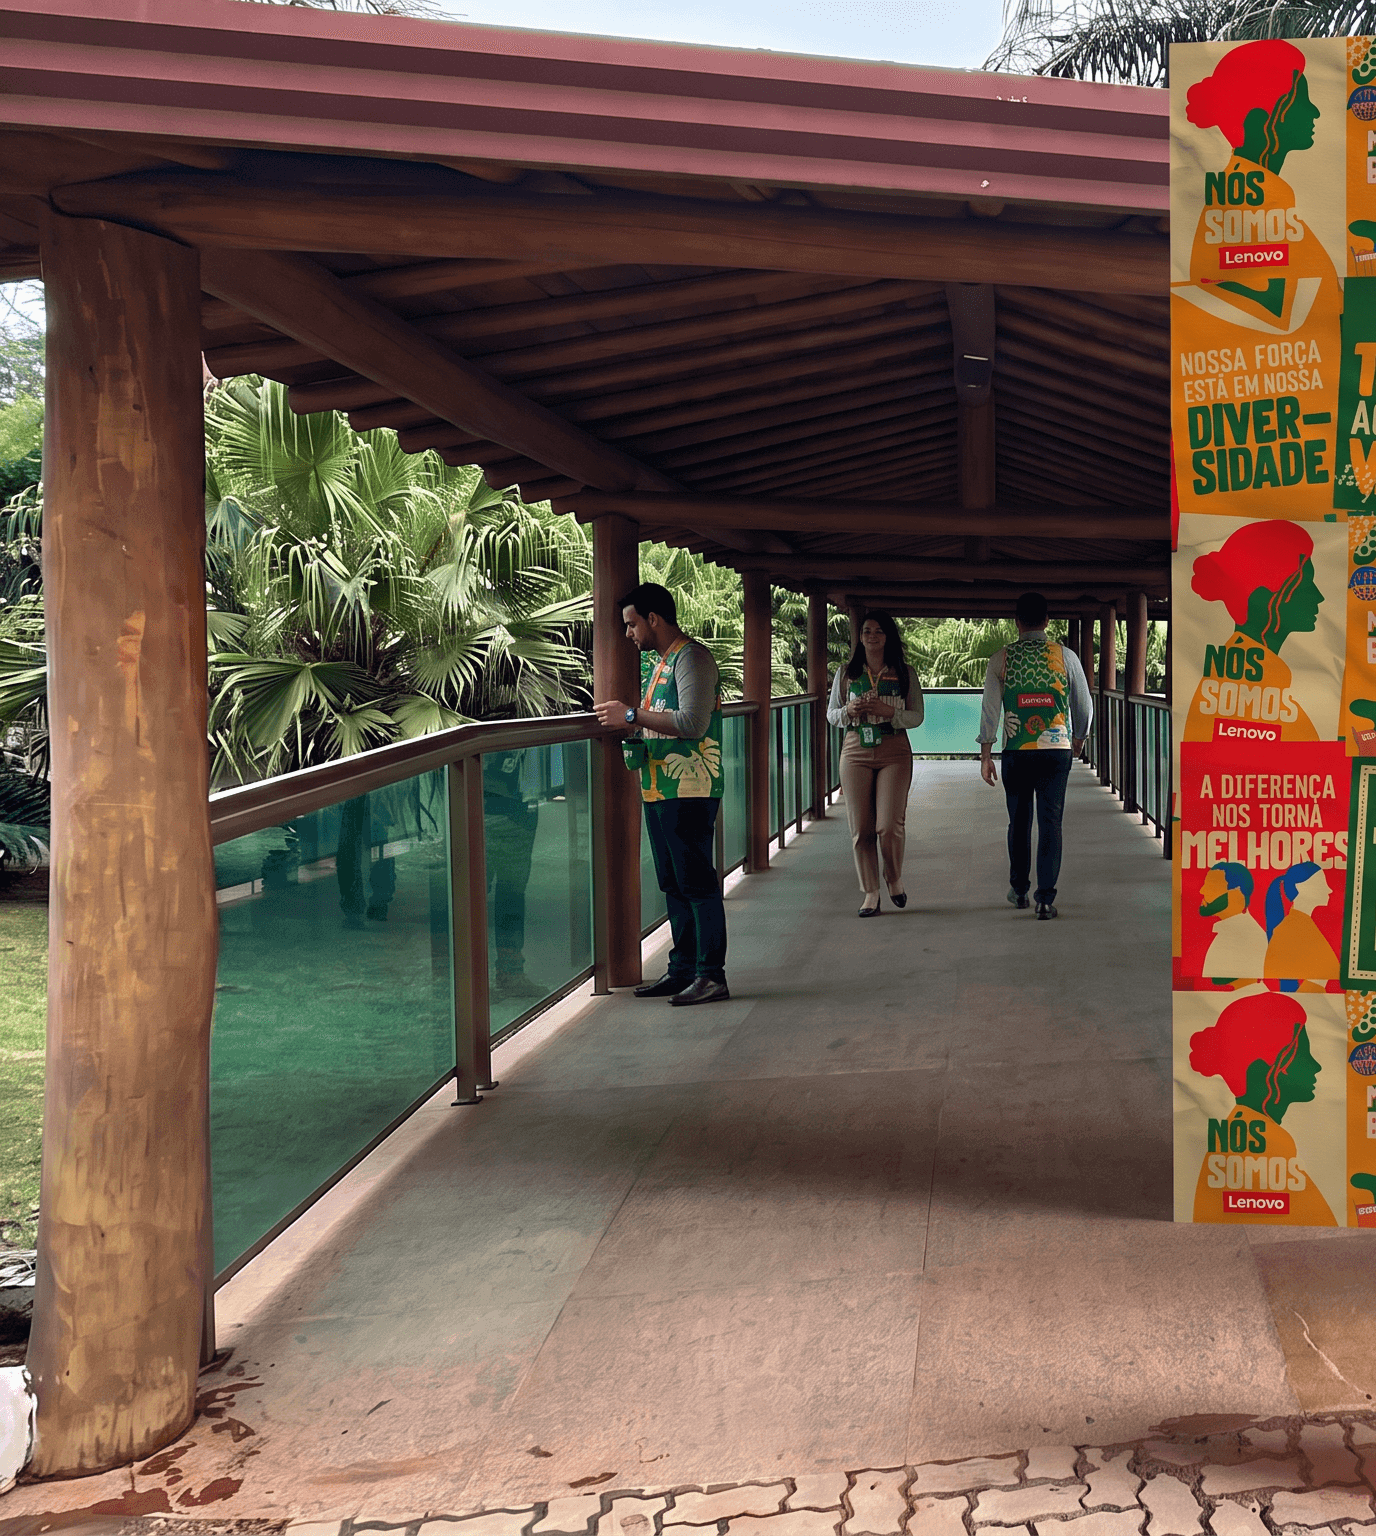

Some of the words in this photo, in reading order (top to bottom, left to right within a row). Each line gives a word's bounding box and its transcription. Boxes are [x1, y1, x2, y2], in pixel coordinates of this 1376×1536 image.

[1205, 162, 1264, 206] NÓS
[1205, 206, 1304, 244] SOMOS
[1225, 249, 1284, 264] Lenovo
[1180, 348, 1247, 376] NOSSA
[1255, 340, 1322, 369] FORÇA
[1234, 376, 1260, 398] EM
[1263, 367, 1323, 392] NOSSA
[1192, 439, 1329, 496] SIDADE
[1203, 636, 1264, 682] NÓS
[1199, 679, 1298, 723] SOMOS
[1219, 723, 1276, 741] Lenovo
[1200, 774, 1213, 799] A
[1221, 774, 1336, 802] DIFERENÇA
[1212, 803, 1250, 828] NOS
[1181, 830, 1348, 870] MELHORES
[1208, 1111, 1266, 1154] NÓS
[1208, 1154, 1306, 1191] SOMOS
[1228, 1196, 1284, 1210] Lenovo
